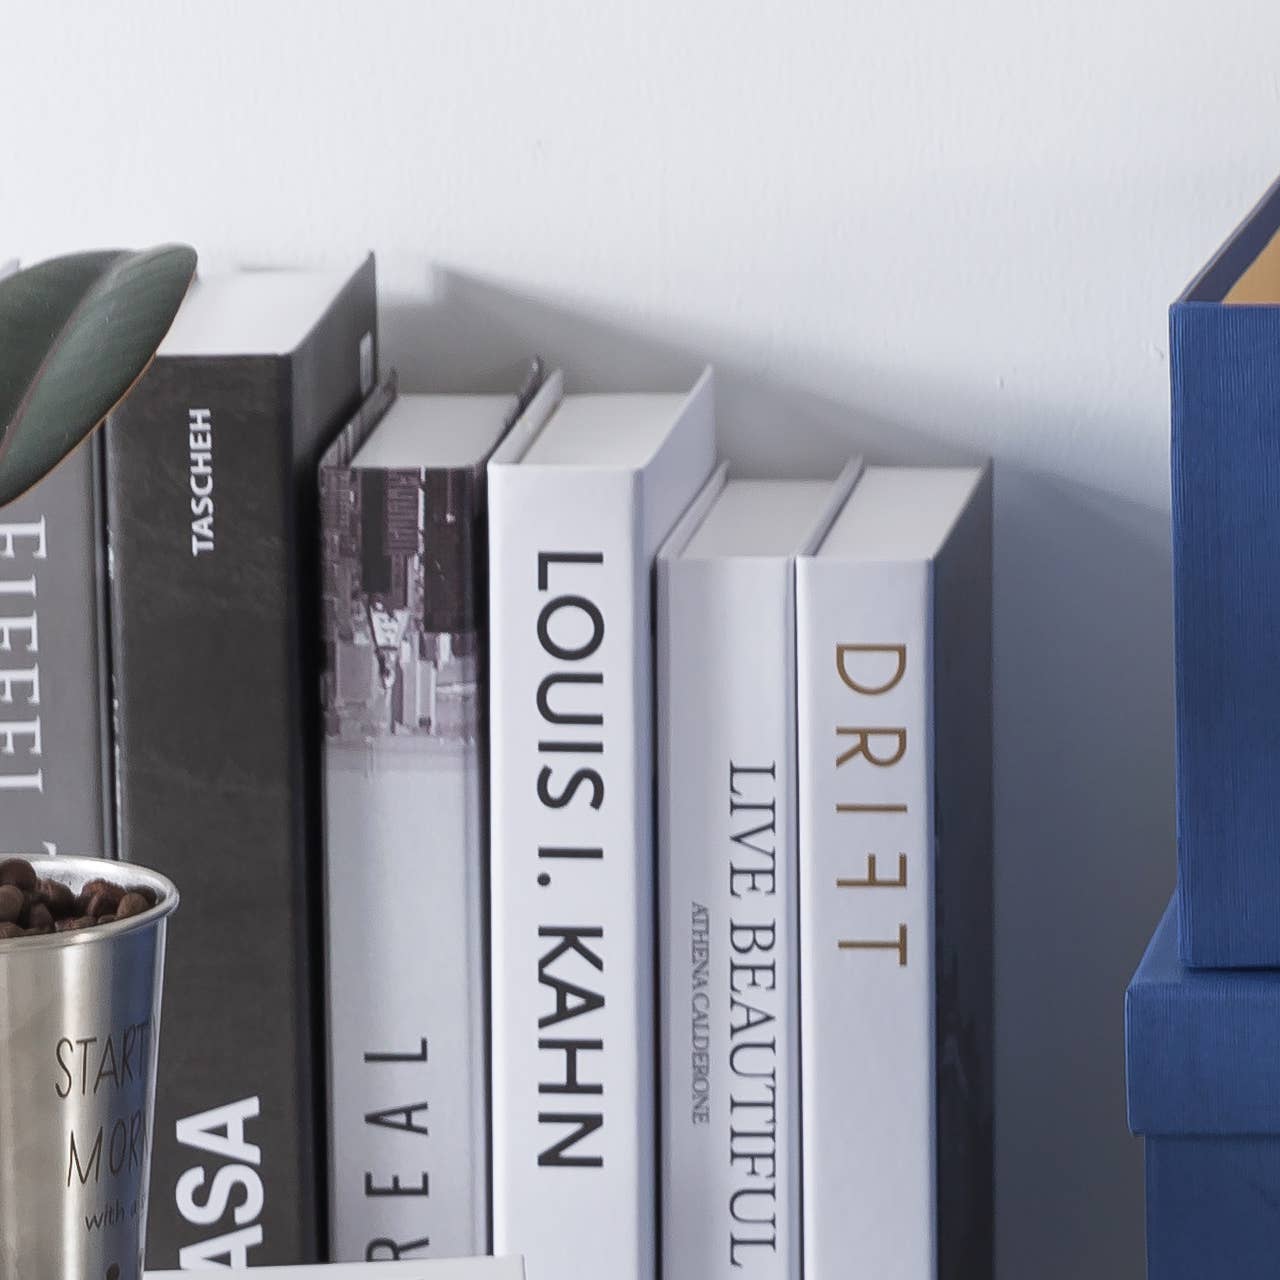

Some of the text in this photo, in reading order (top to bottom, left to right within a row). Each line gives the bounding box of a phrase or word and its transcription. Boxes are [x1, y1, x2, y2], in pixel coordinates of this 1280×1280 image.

[536, 551, 605, 1168] LOUIS I. KAHN
[729, 760, 776, 1268] LIVE BEAUTIFUL
[836, 643, 907, 966] DRIFT
